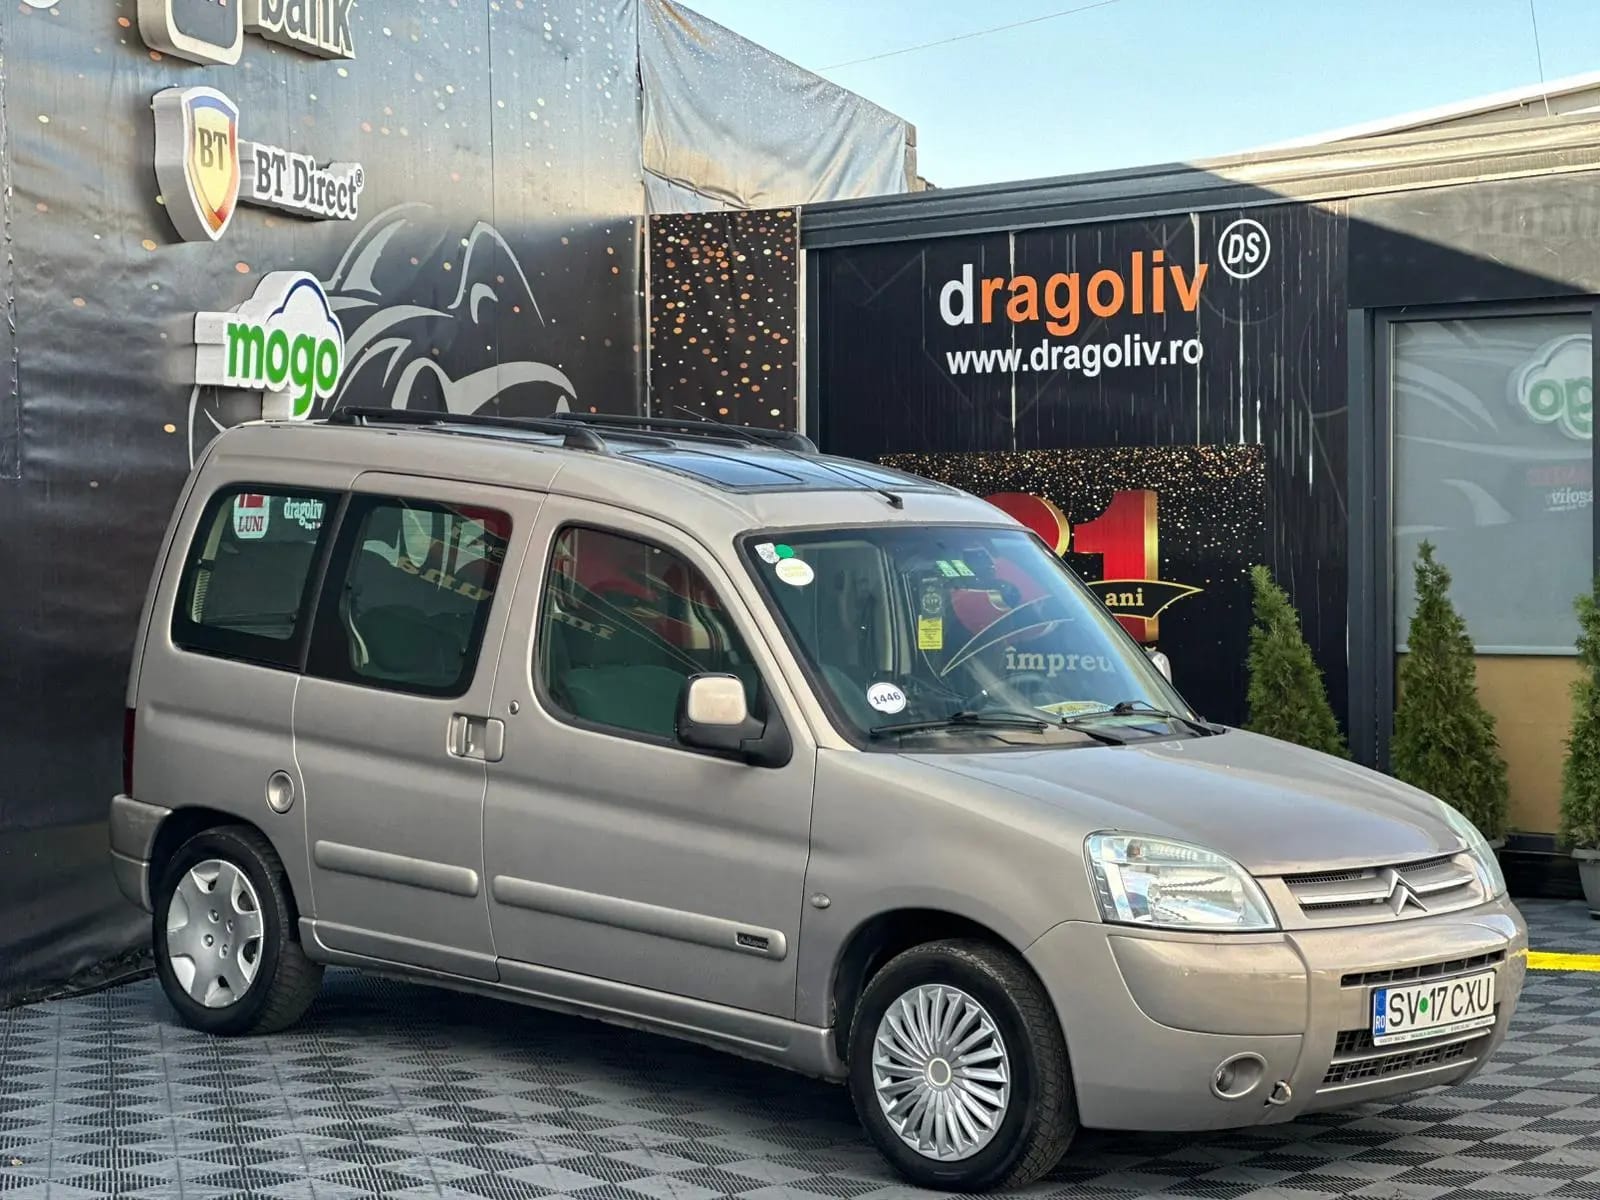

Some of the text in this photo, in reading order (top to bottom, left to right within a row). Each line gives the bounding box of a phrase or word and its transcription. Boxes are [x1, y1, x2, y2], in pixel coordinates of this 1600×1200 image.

[198, 127, 228, 171] BT
[256, 149, 287, 197] BT
[1228, 233, 1261, 264] DS
[939, 250, 1209, 336] dragoliv
[227, 322, 339, 416] mogo
[946, 333, 1204, 377] www.dragoliv.ro
[238, 515, 264, 532] LUNI
[283, 497, 324, 526] dragoliv
[1104, 587, 1145, 607] ani
[872, 691, 901, 705] 1446
[1375, 1015, 1386, 1029] RO
[1389, 990, 1421, 1027] SV
